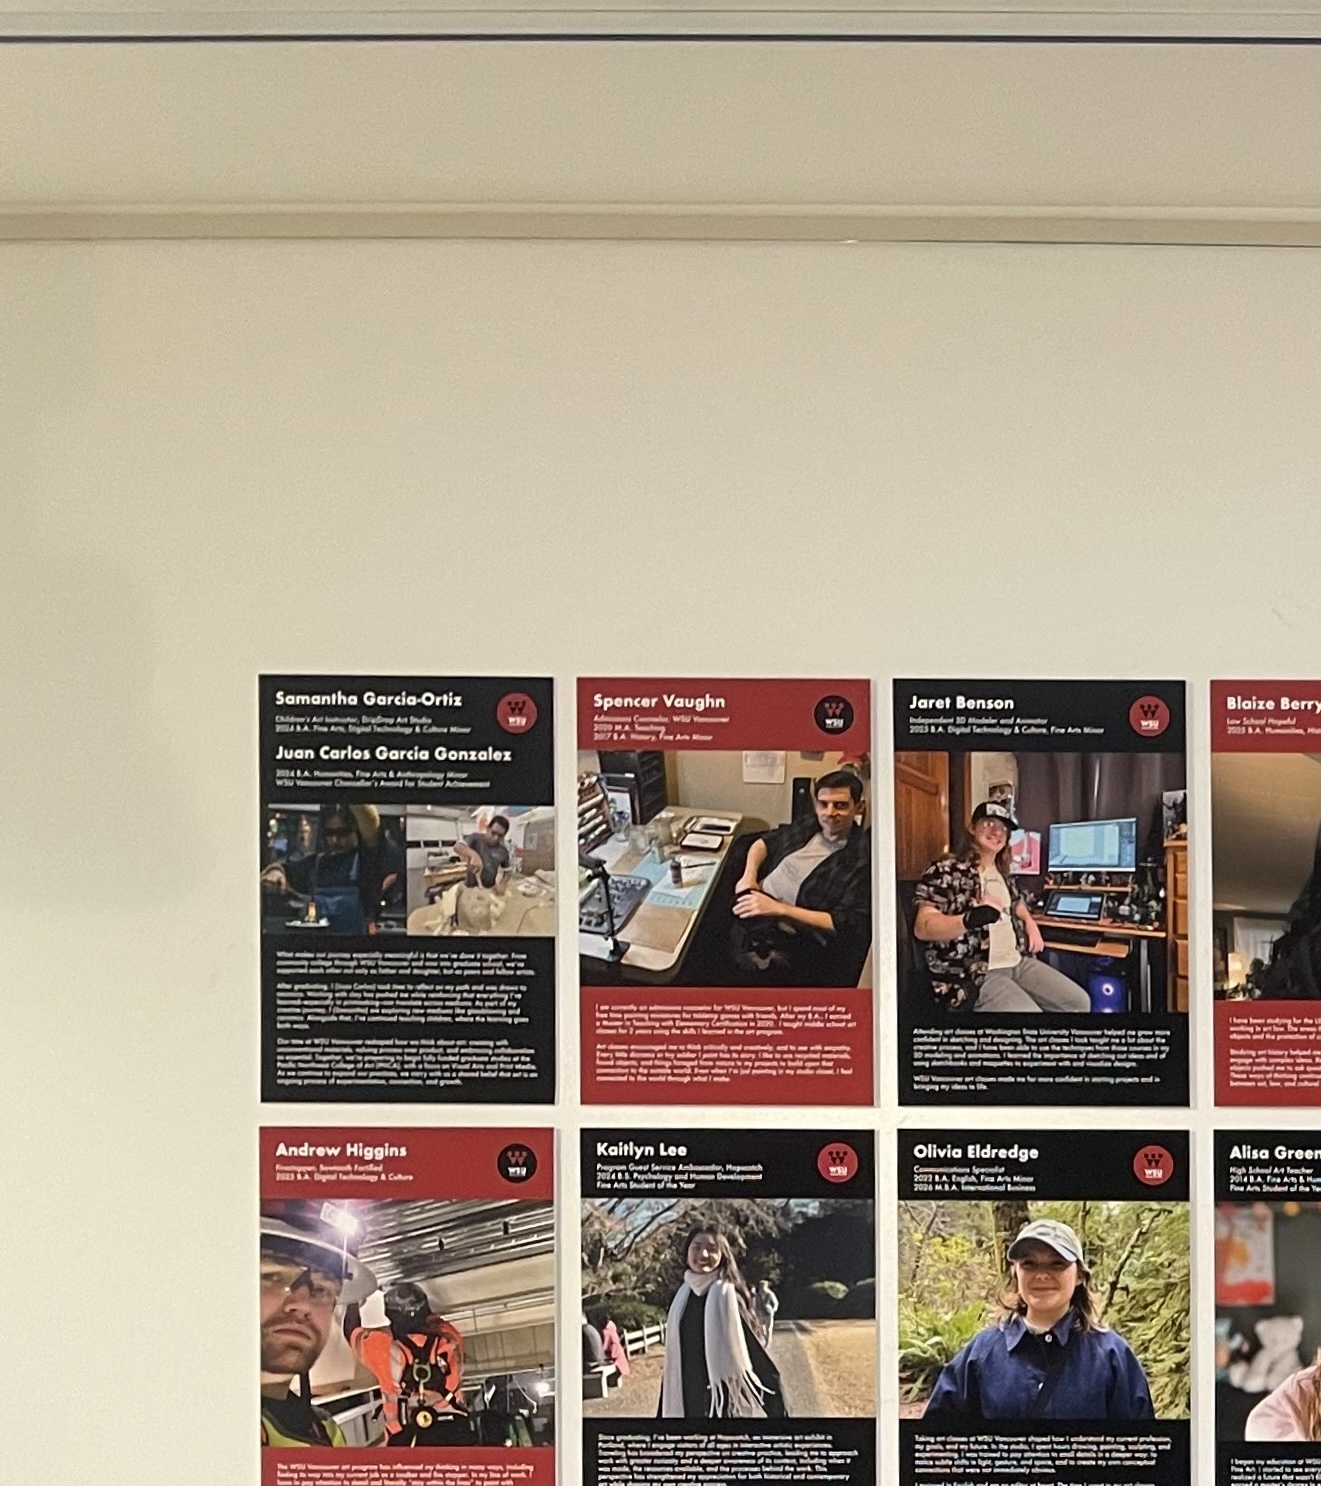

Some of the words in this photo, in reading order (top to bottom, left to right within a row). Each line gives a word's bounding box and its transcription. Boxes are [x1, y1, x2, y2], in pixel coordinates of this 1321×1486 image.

[276, 691, 357, 705] Samantha
[594, 694, 658, 710] Spencer
[663, 694, 725, 711] Vaughn
[910, 696, 951, 708] Jaret
[956, 696, 1014, 709] Benson
[1227, 696, 1275, 710] Blaize
[276, 746, 314, 759] Juan
[320, 745, 370, 759] Carlos
[435, 747, 511, 761] Gonzalez
[276, 1143, 341, 1156] Andrew
[346, 1143, 406, 1160] Higgins
[597, 1142, 654, 1159] Kaitlyn
[660, 1143, 687, 1156] Lee
[914, 1144, 962, 1158] Olivia
[968, 1144, 1038, 1162] Eldredge
[1230, 1145, 1269, 1159] Alisa
